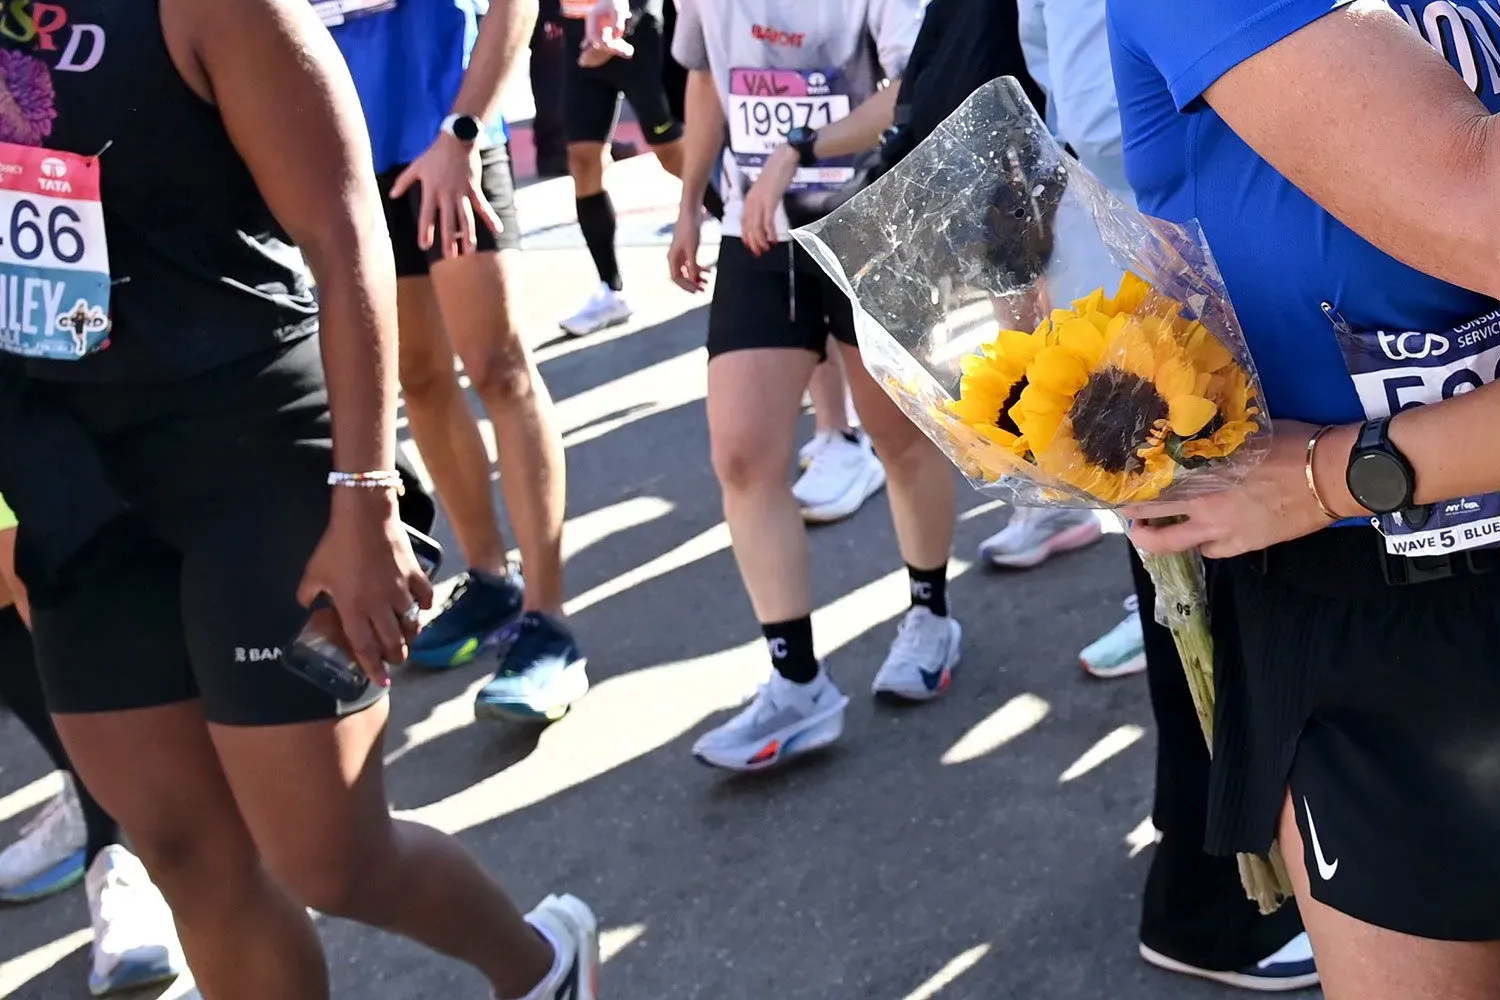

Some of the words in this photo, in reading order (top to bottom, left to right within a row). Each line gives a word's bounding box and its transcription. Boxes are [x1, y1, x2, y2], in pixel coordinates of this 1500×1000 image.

[0, 0, 106, 73] SRD
[743, 72, 790, 96] VAL
[738, 100, 832, 137] 19971
[37, 177, 73, 194] TATA
[0, 198, 85, 264] 66
[0, 273, 66, 338] ILEY
[1377, 330, 1450, 361] tcs
[1392, 535, 1437, 555] WAVE
[1439, 529, 1456, 549] 5
[249, 646, 283, 662] BAN
